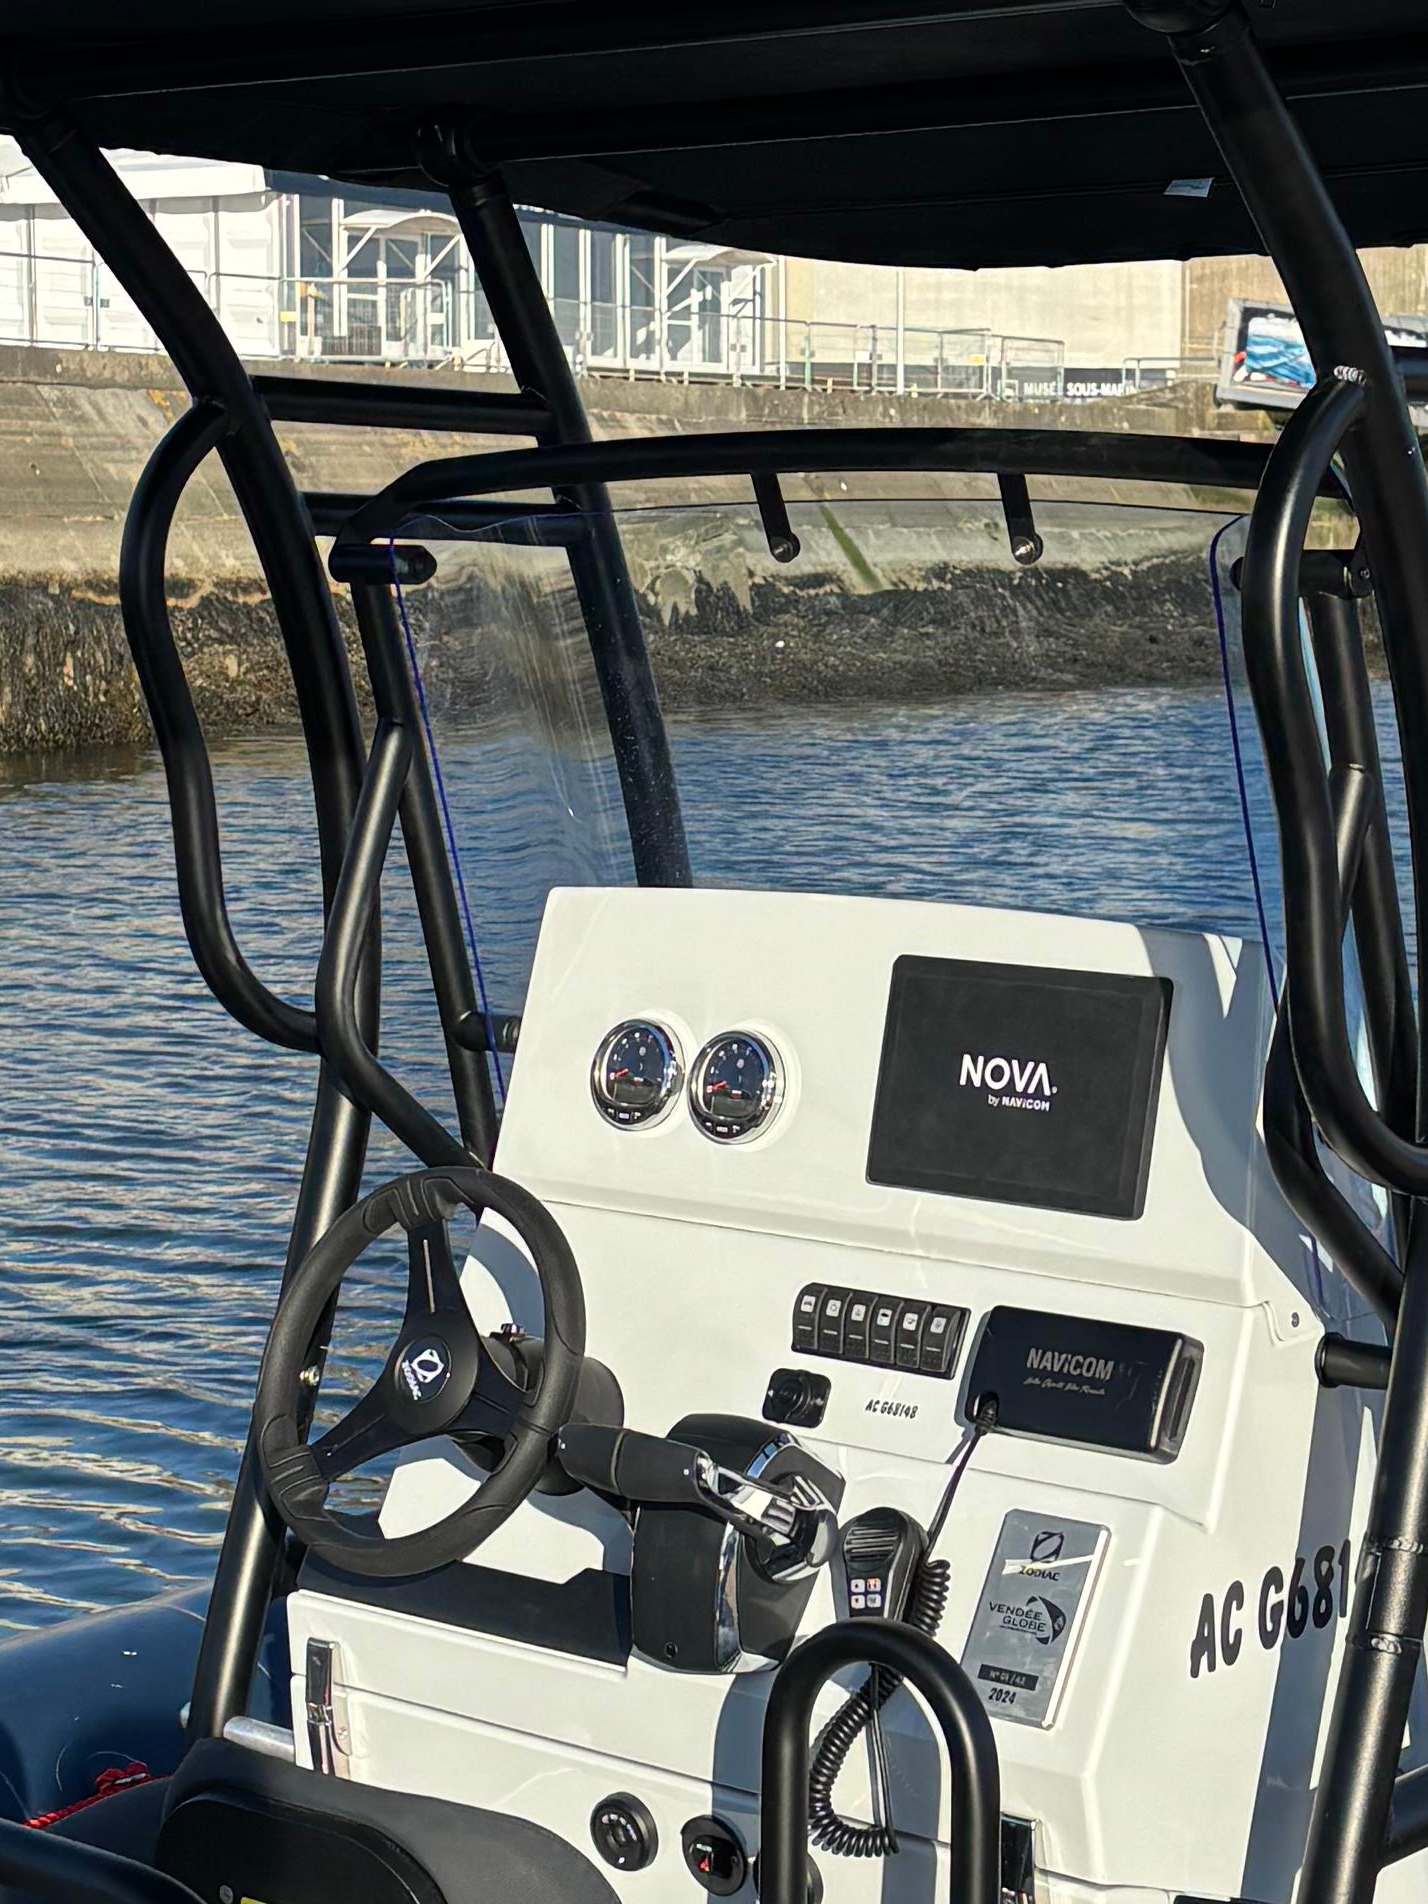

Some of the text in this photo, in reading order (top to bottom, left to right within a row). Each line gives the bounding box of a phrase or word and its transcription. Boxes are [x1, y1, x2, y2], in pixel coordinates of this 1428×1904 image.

[959, 1053, 1052, 1097] NOVA
[987, 1094, 1000, 1107] by
[865, 1398, 880, 1413] AC
[1018, 1565, 1061, 1582] ZODIAC
[989, 1600, 1043, 1621] VENDÉE
[1190, 1538, 1352, 1679] AC G681
[1002, 1615, 1047, 1633] GLOBE
[988, 1687, 1017, 1705] 2024
